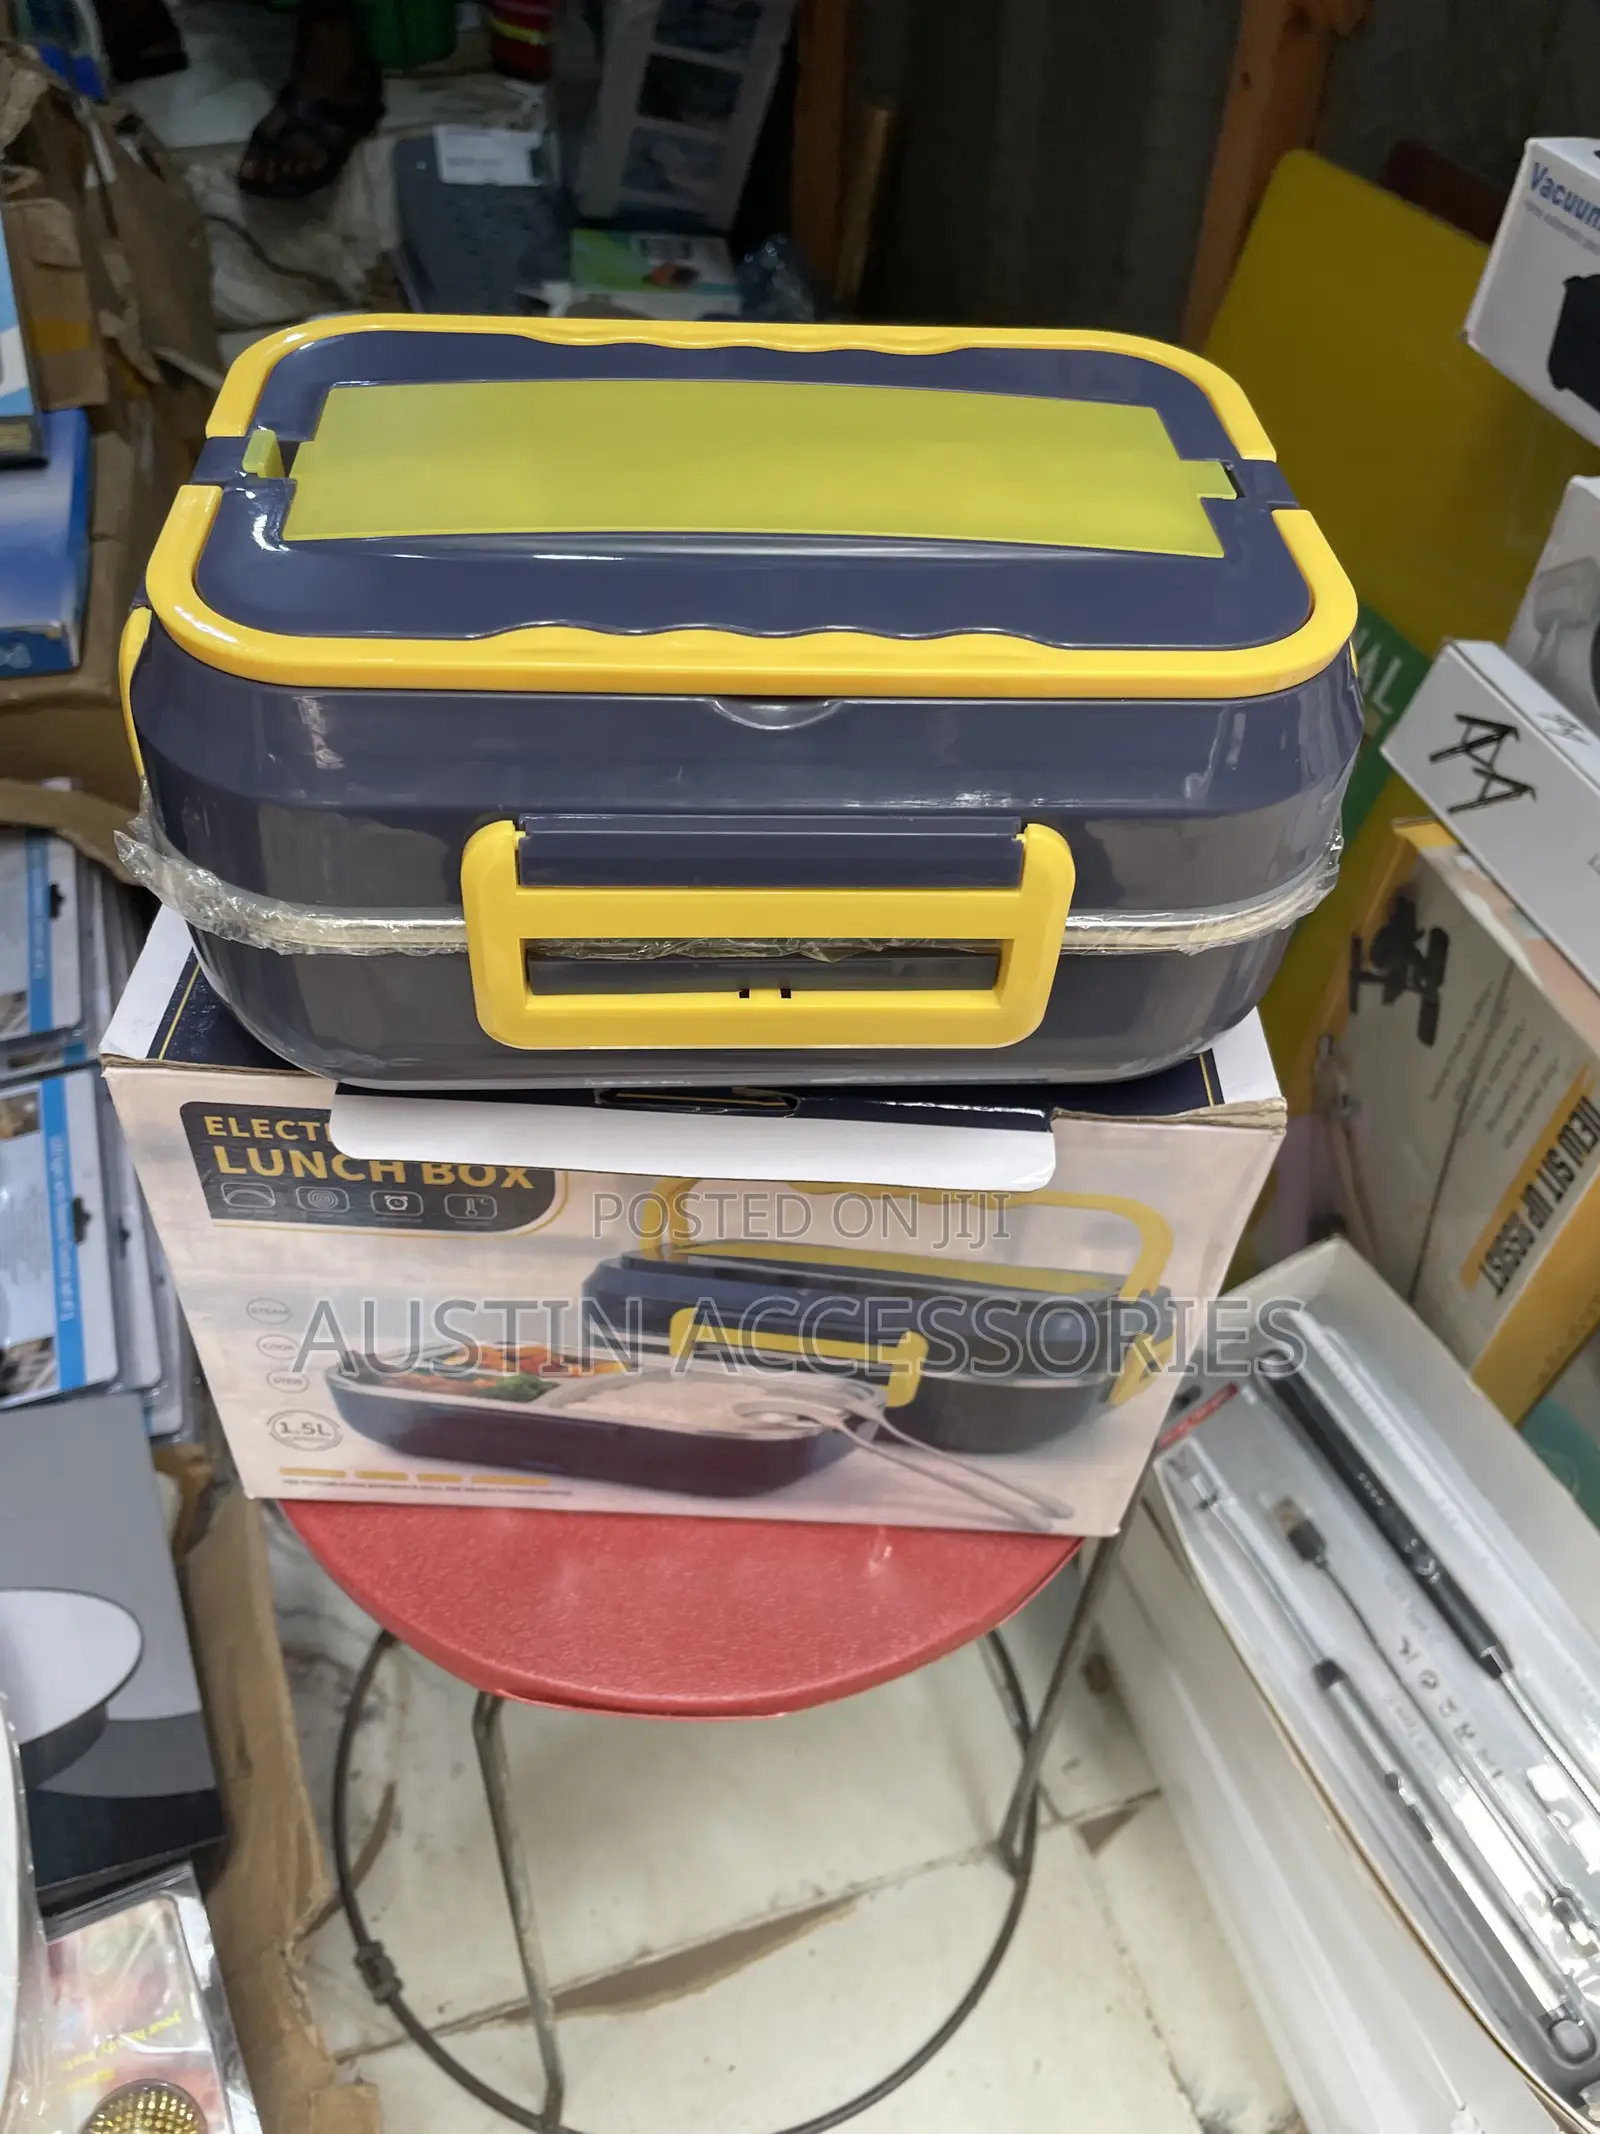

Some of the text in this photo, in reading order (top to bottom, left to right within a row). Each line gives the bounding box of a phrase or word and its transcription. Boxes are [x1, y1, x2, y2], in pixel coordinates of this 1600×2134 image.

[204, 1115, 332, 1142] ELECT
[213, 1145, 535, 1189] LUNCH BOX
[280, 1422, 333, 1436] 1.5L
